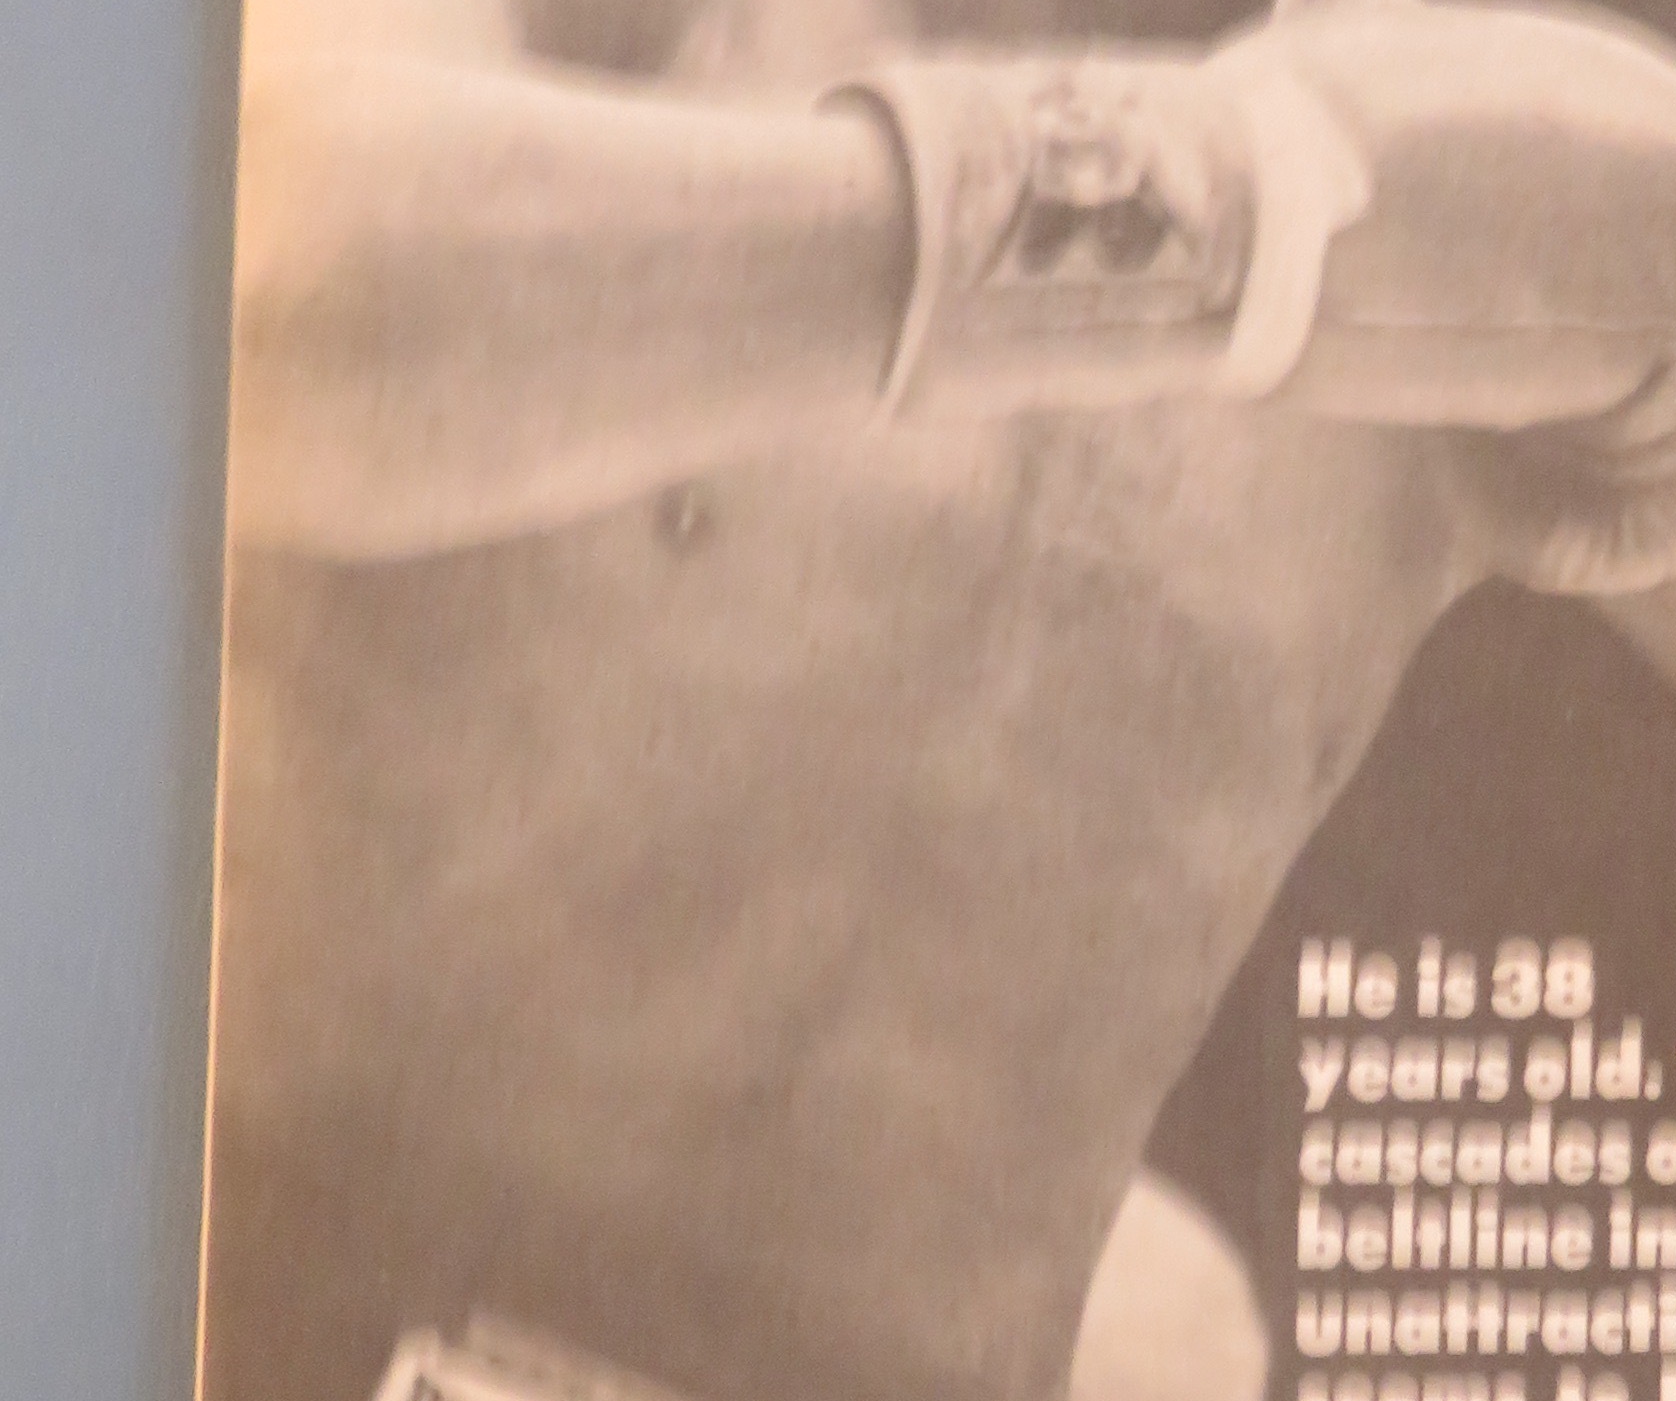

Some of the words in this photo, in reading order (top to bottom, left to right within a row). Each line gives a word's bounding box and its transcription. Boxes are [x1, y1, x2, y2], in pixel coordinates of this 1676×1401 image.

[1297, 936, 1398, 1019] He
[1417, 936, 1475, 1018] is
[1491, 936, 1594, 1019] 38
[1298, 1035, 1511, 1111] years
[1524, 1015, 1663, 1100] old.
[1298, 1102, 1631, 1185] cascades
[1297, 1186, 1594, 1270] beltline
